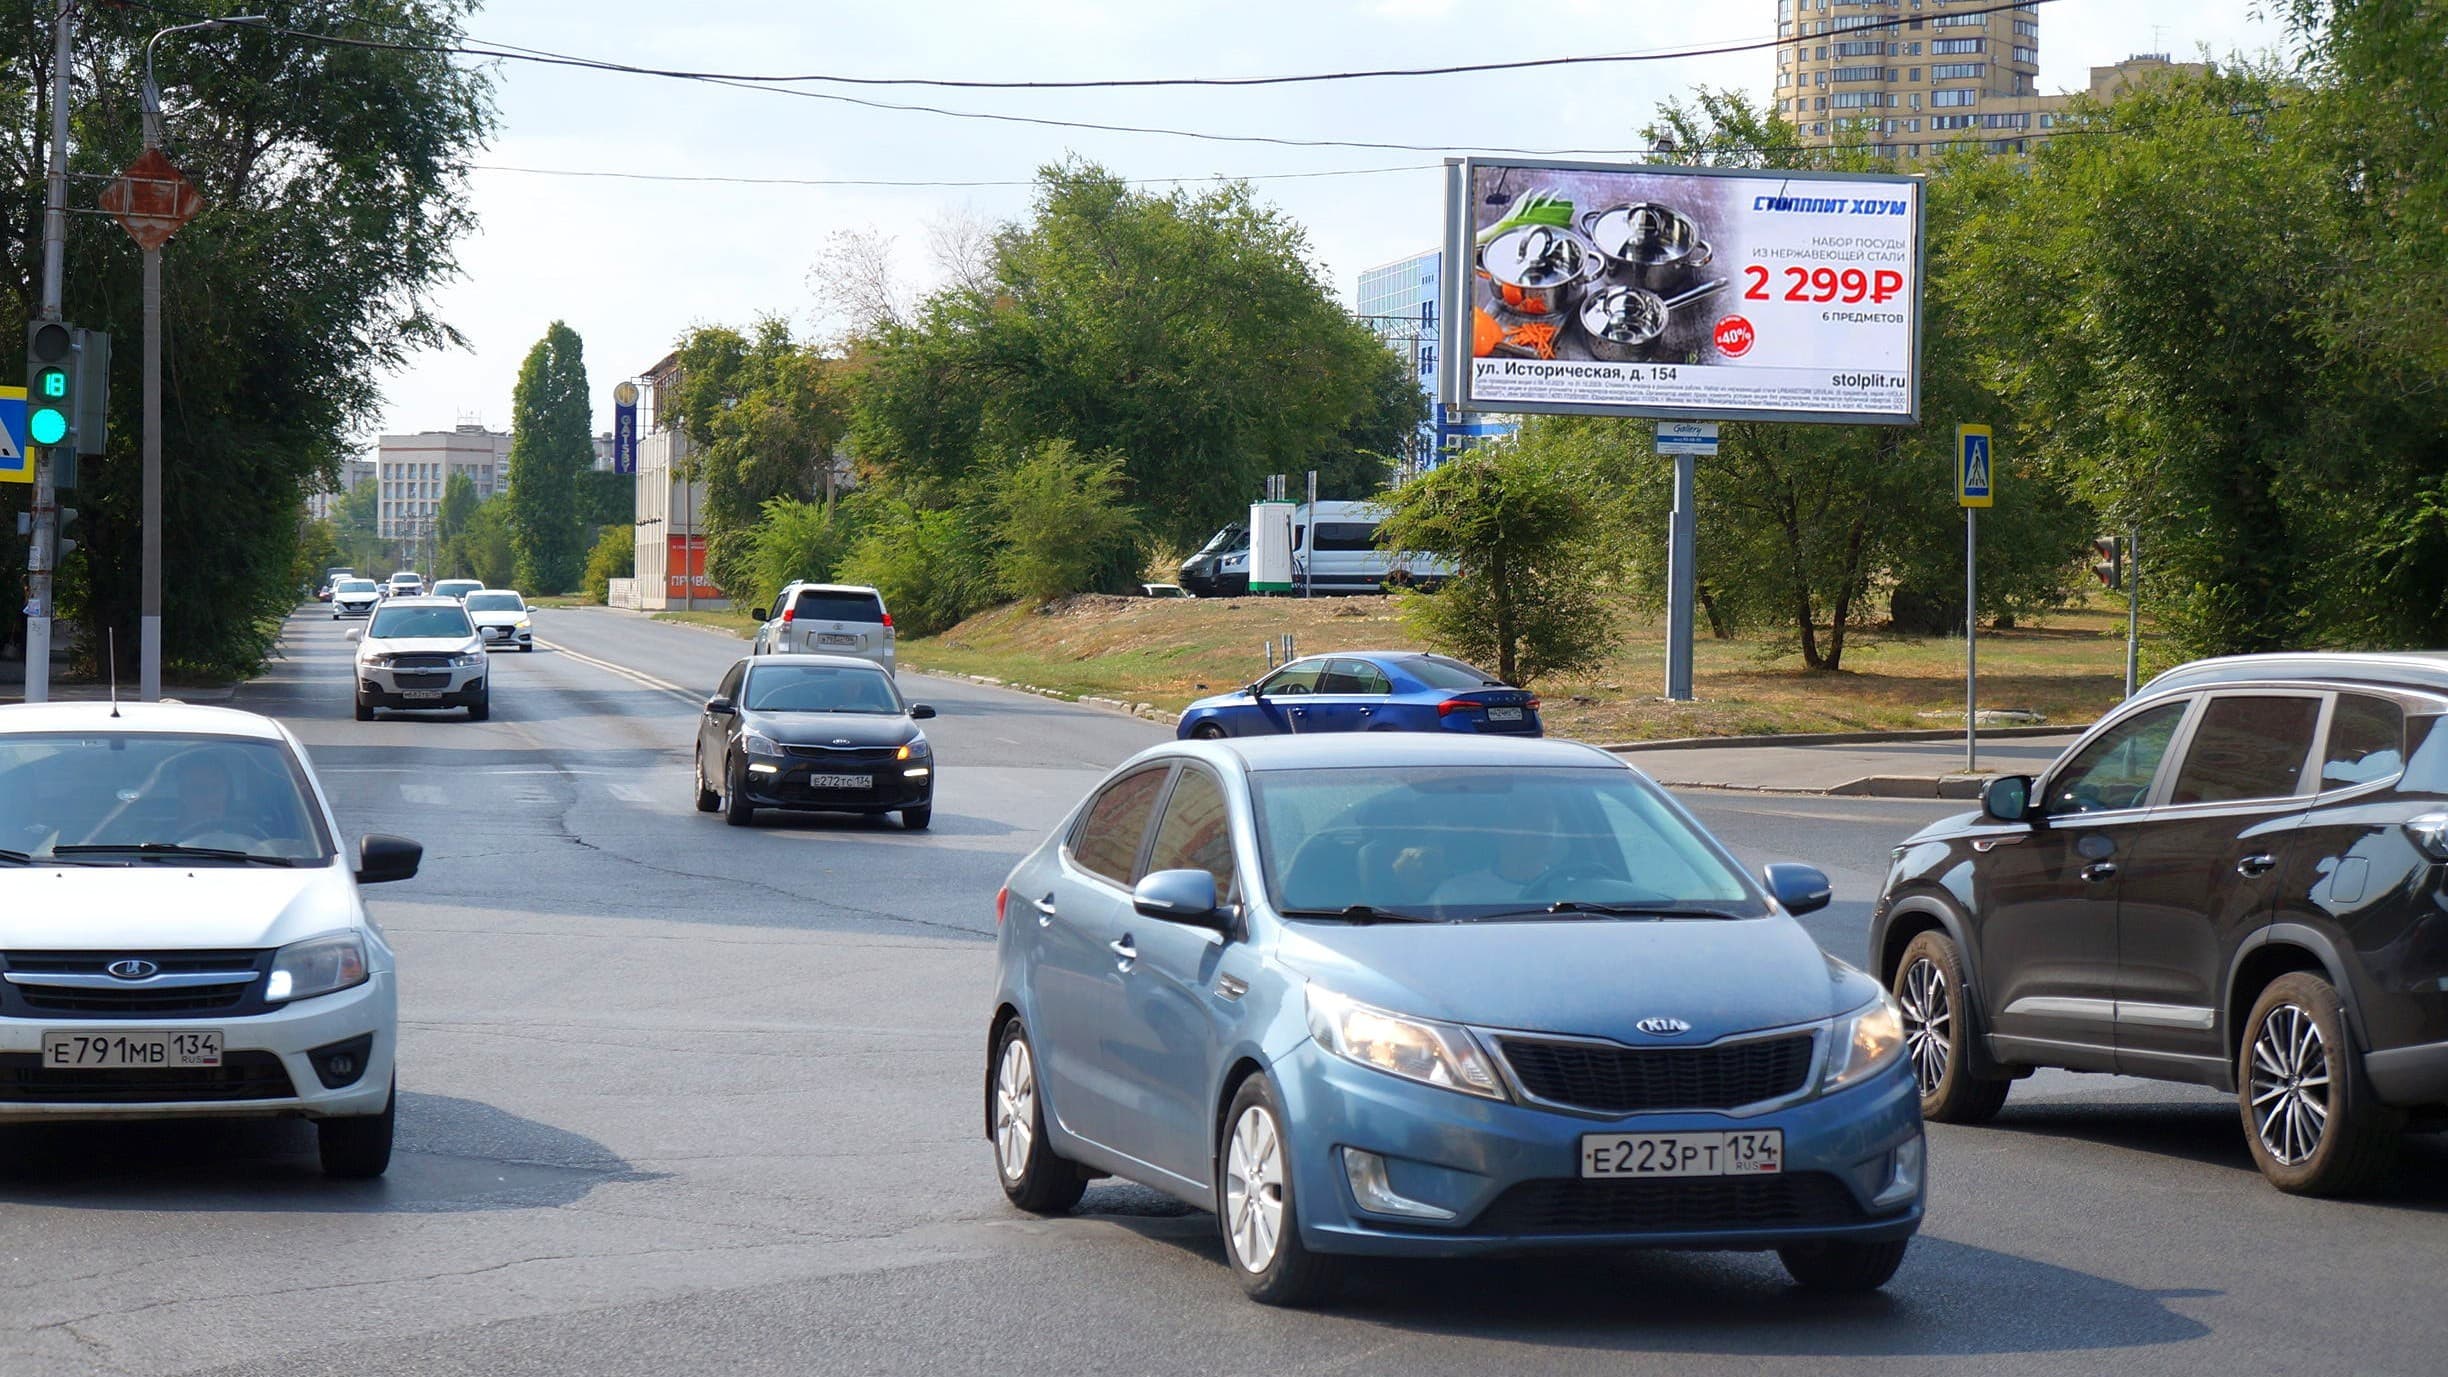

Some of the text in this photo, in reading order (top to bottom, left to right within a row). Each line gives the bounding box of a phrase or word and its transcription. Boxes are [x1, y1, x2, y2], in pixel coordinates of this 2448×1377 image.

[1851, 199, 1907, 216] ХОУМ
[1812, 236, 1906, 250] НАБОР ПОСУДЫ
[1752, 247, 1906, 262] ИЗ НЕРЖАВЕЮЩЕЙ СТАЛИ
[1744, 265, 1770, 300] 2
[1822, 312, 1904, 324] 6 ПРЕДМЕТОВ
[1476, 361, 1678, 381] ул. Историческая, д. 154
[46, 373, 65, 397] 18
[1831, 372, 1906, 390] stolplit.ru
[620, 415, 632, 473] GATSBY
[1638, 1017, 1690, 1035] KIA
[54, 1034, 214, 1064] Е791МВ 134
[181, 1055, 203, 1064] RUS
[1593, 1134, 1772, 1173] Е223РТ 134
[1735, 1161, 1759, 1171] RUS
